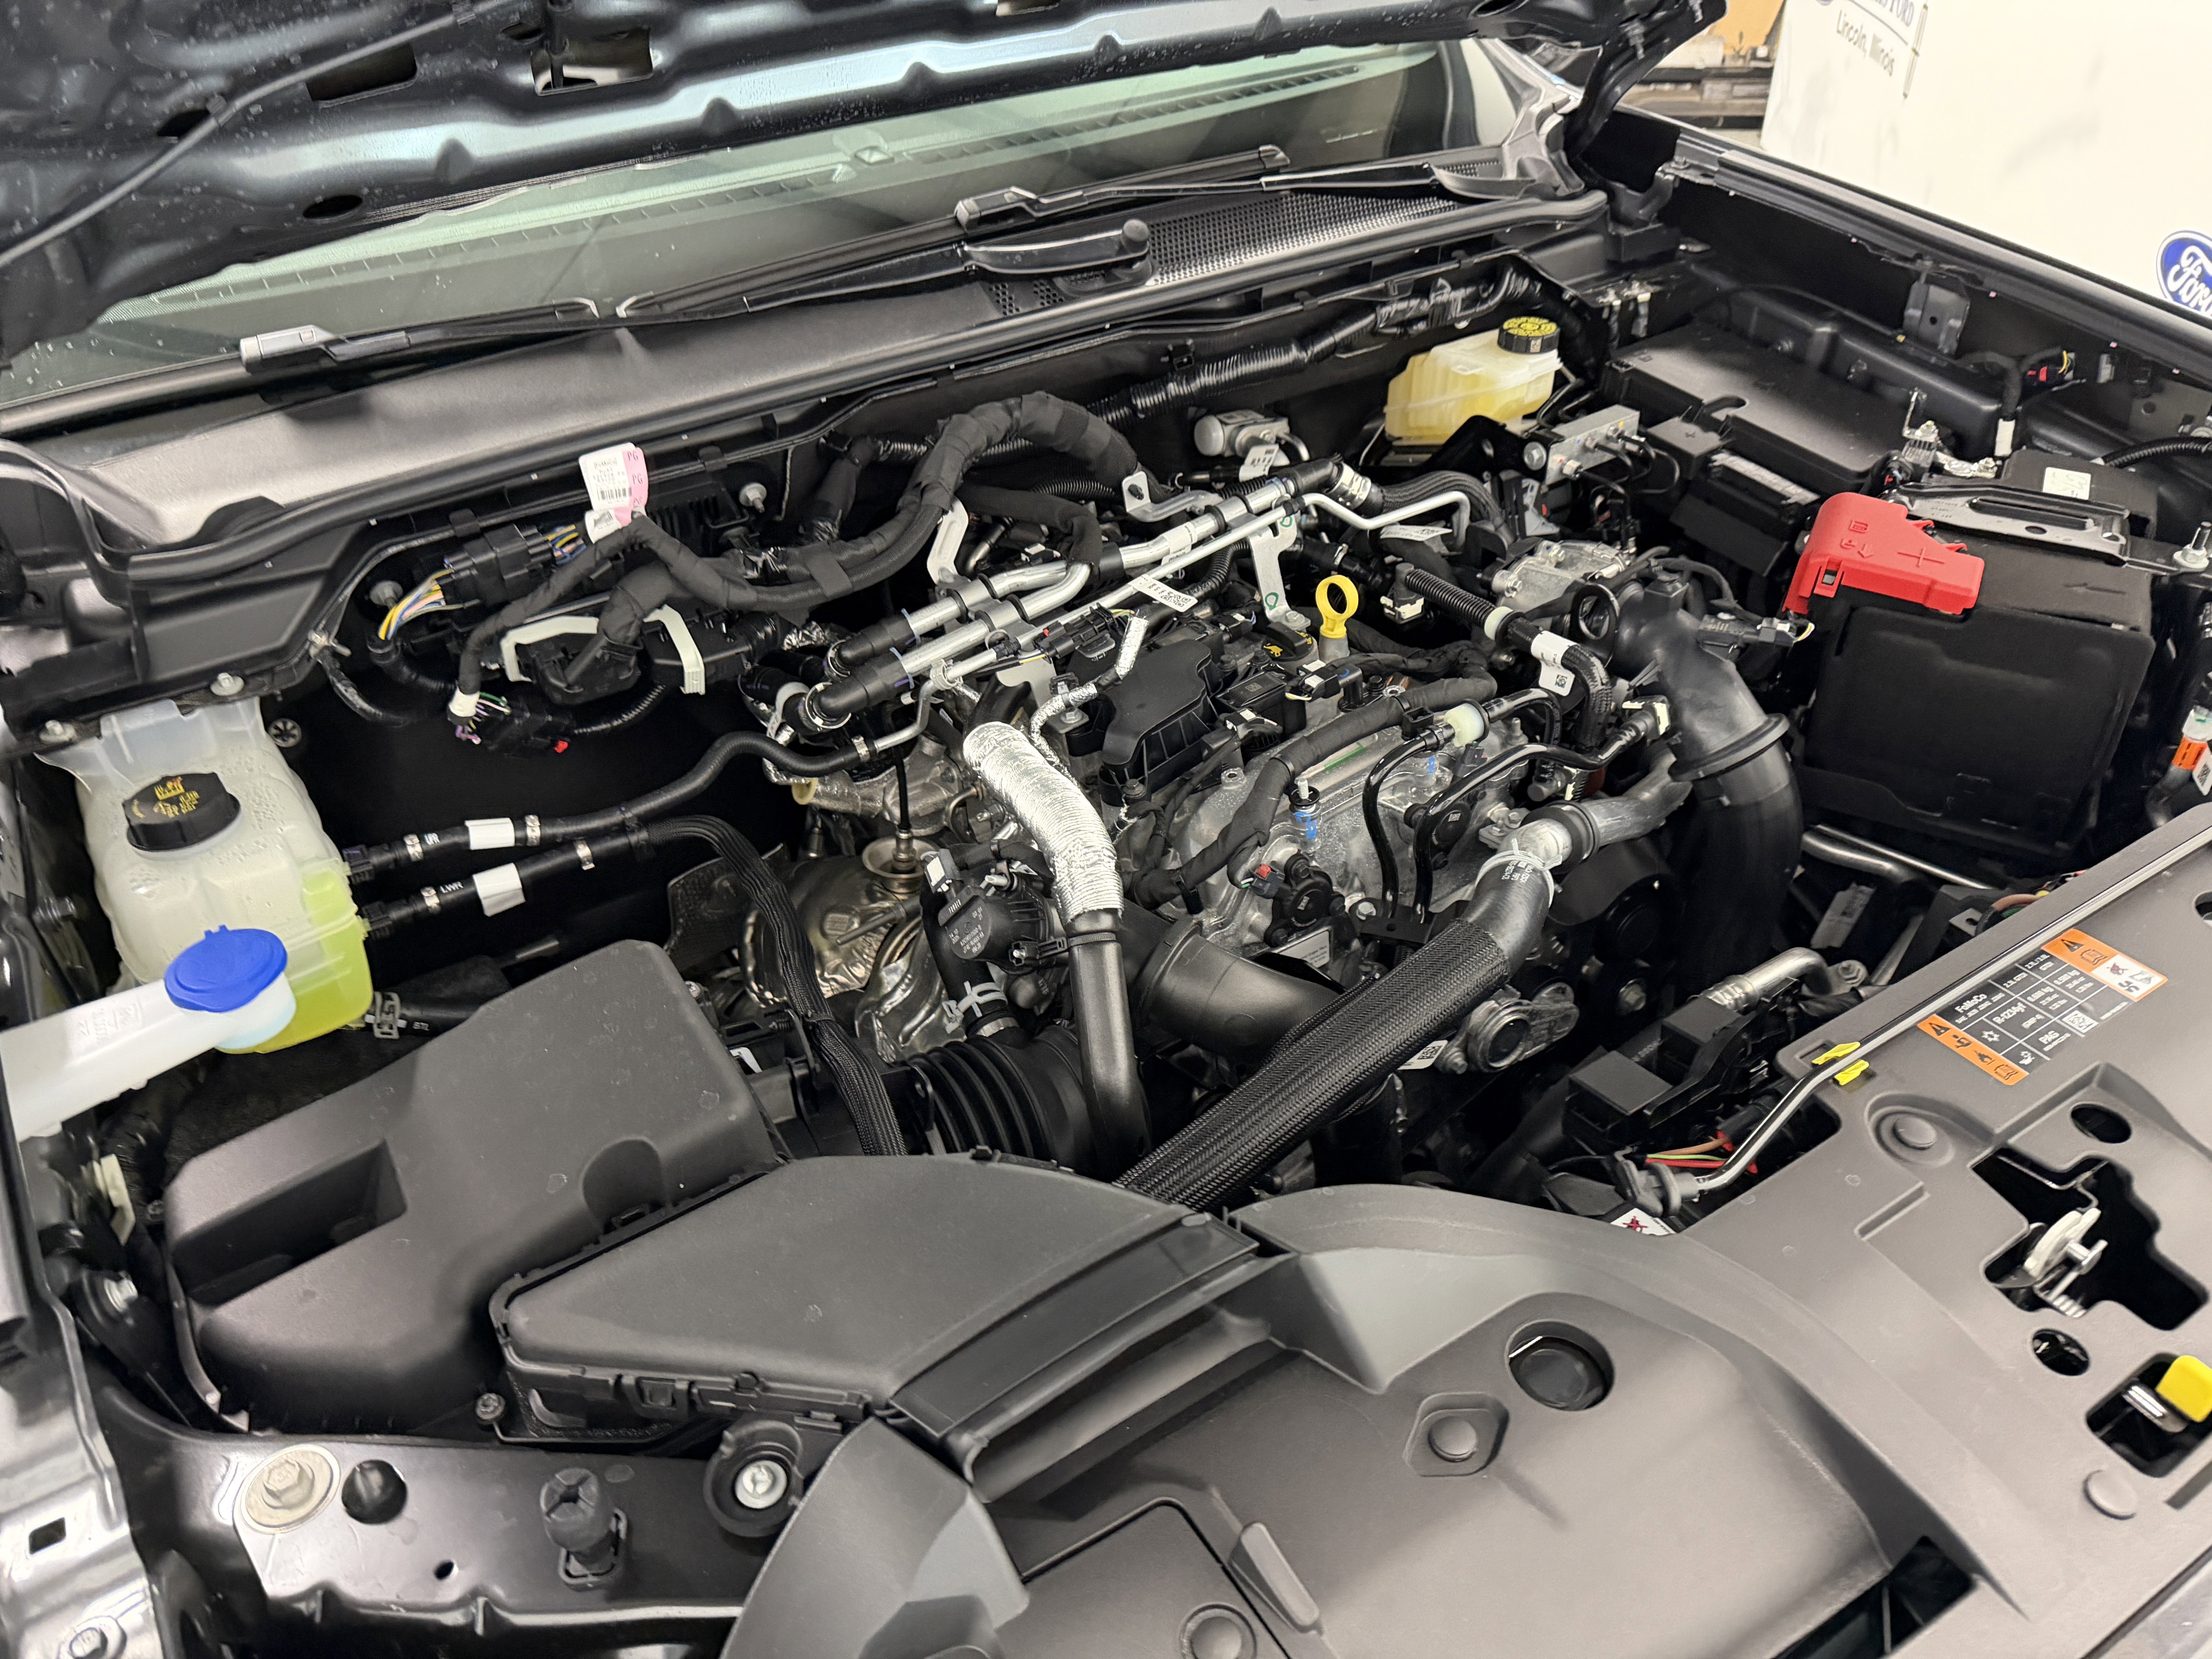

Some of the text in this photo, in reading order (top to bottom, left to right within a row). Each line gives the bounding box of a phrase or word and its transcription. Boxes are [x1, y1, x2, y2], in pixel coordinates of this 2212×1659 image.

[627, 452, 638, 462] PG
[632, 474, 643, 484] PG
[1955, 994, 1987, 1013] FoMoCo
[2039, 1030, 2059, 1044] PAG
